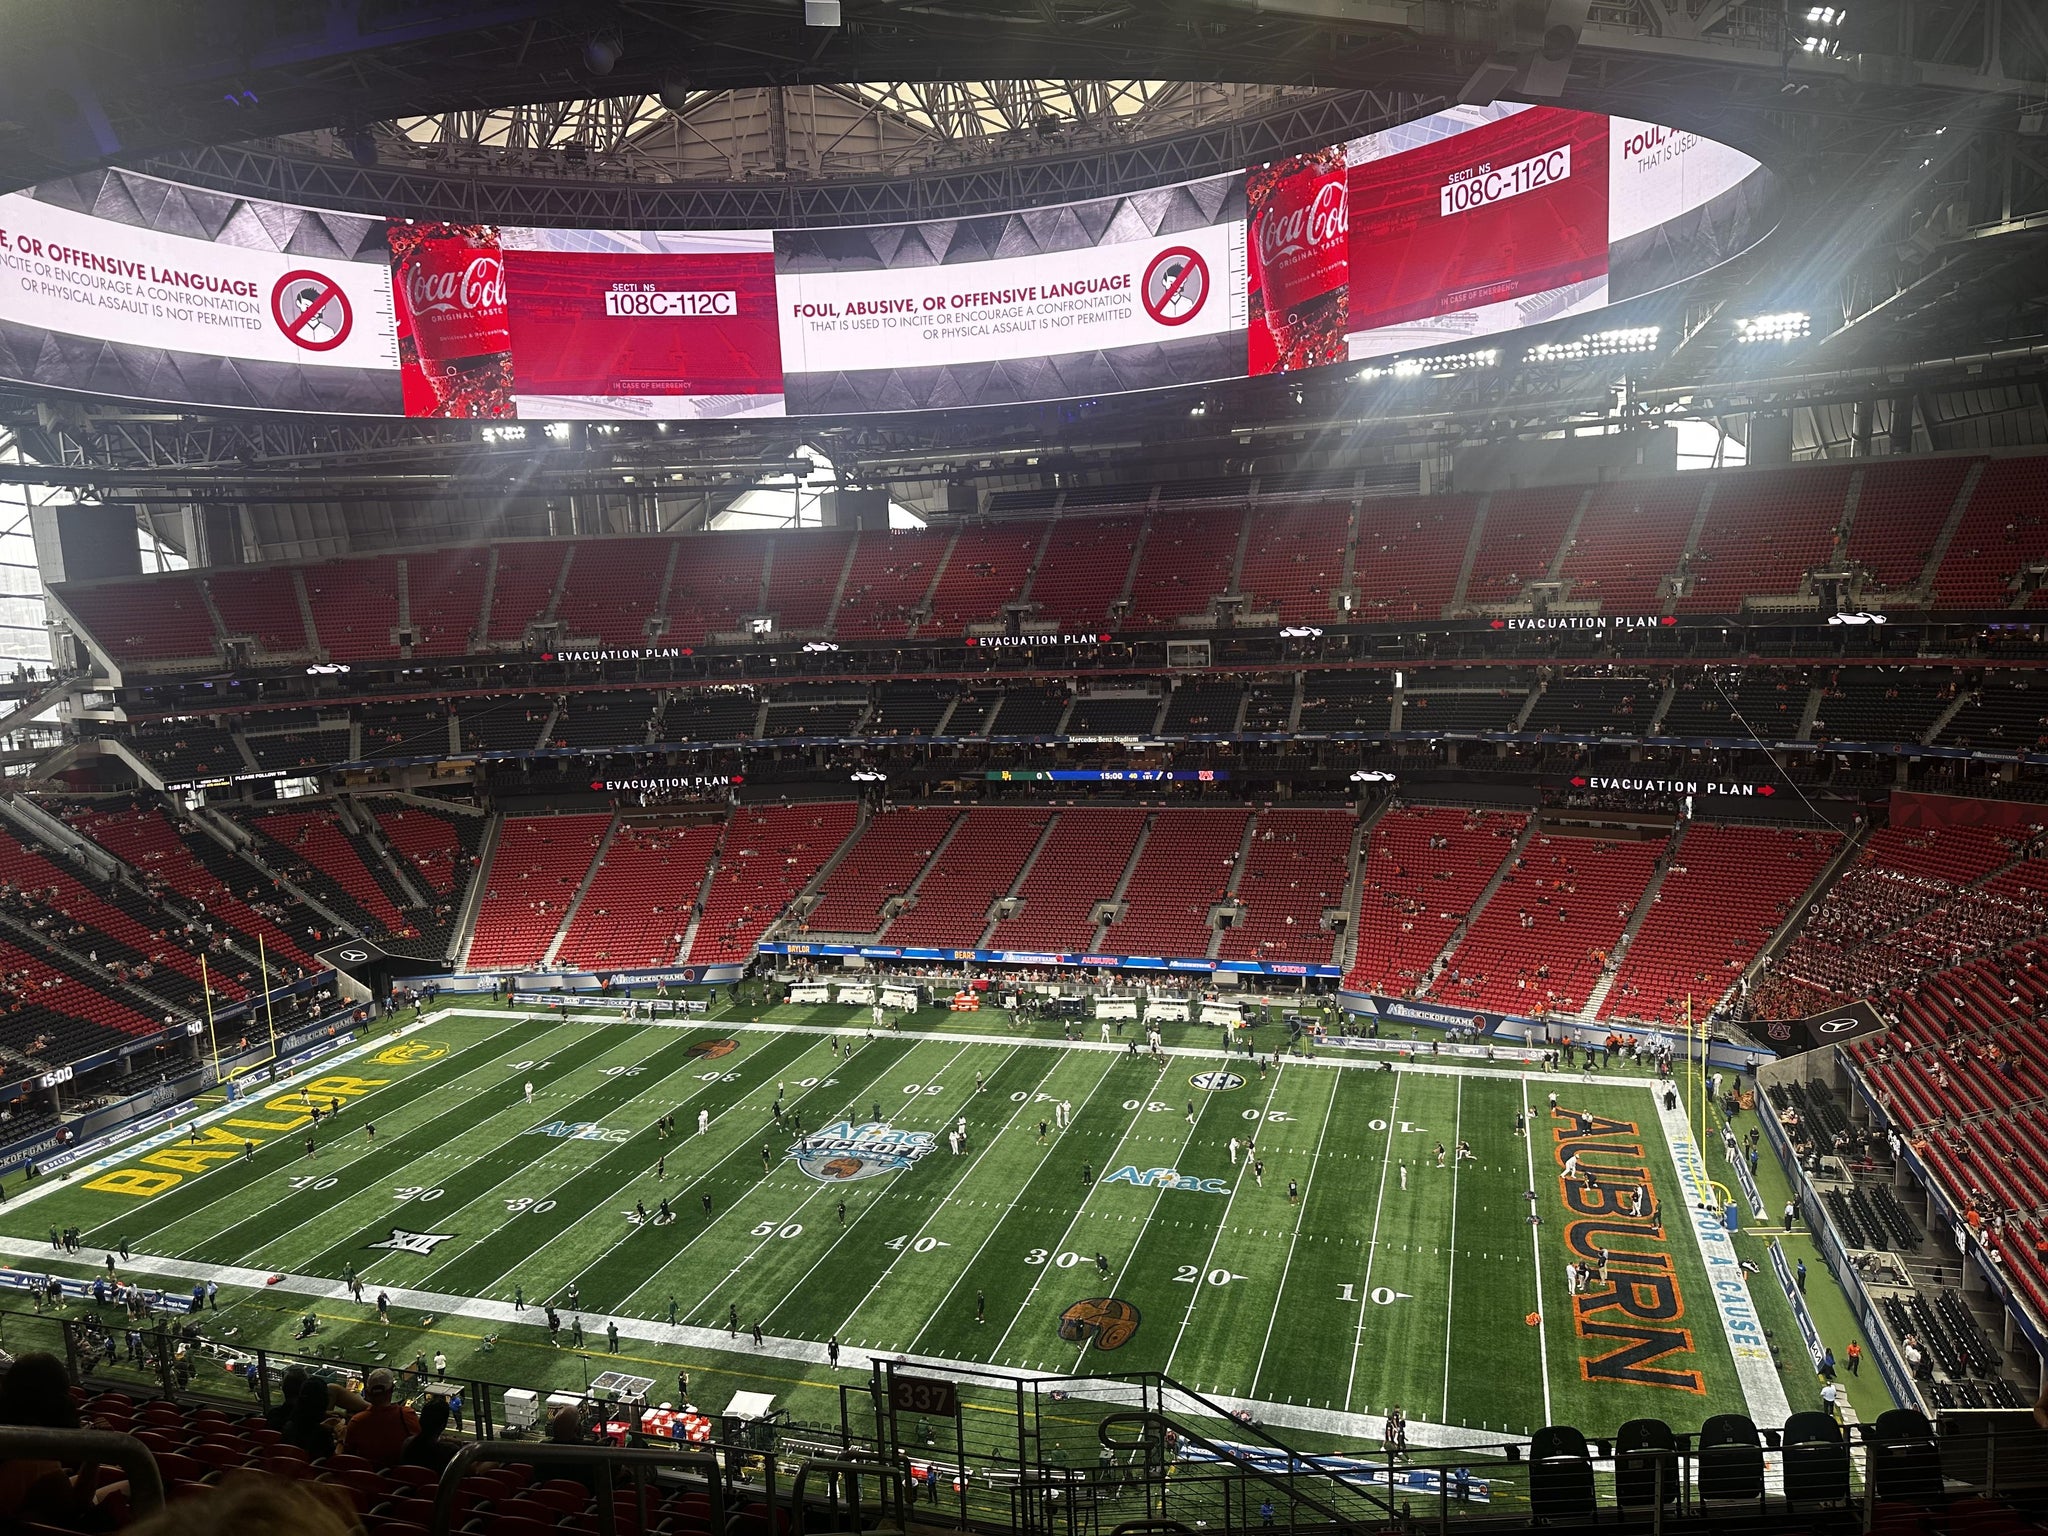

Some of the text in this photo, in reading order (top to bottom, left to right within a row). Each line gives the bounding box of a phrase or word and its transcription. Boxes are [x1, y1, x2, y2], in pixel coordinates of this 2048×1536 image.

[1624, 126, 1665, 160] FOUL,
[1638, 134, 1697, 173] THAT IS USED
[1445, 151, 1564, 212] 108C-112C
[1448, 163, 1491, 184] SECTINS
[1279, 236, 1345, 269] ORIGINAL TASTE
[17, 235, 258, 298] OR OFFENSIVE LANGUAGE
[34, 262, 52, 278] OR
[54, 267, 133, 295] ENCOURAGE
[136, 285, 145, 298] A
[148, 287, 261, 314] CONFRONTATION
[612, 283, 656, 292] SECTINS
[793, 273, 1131, 319] FOUL, ABUSIVE, OR OFFENSIVE LANGUAGE
[1450, 293, 1467, 304] CASE
[1478, 281, 1519, 298] EMERGENCY
[21, 277, 262, 331] OR PHYSICAL ASSAULT IS NOT PERMITTED
[609, 292, 731, 315] 108C-112C
[810, 292, 1132, 332] THAT IS USED TO INCITE OR ENCOURAGE A CONFRONTATION
[431, 307, 503, 323] ORIGINAL TASTE
[922, 307, 1132, 340] OR PHYSICAL ASSAULT IS NOT PERMITTED
[1508, 616, 1658, 630] EVACUATION PLAN
[980, 633, 1097, 647] EVACUATION PLAN
[557, 648, 679, 662] EVACUATION PLAN
[1069, 735, 1139, 743] Mercedes-Benz Stadium
[606, 775, 729, 790] EVACUATION PLAN
[1036, 772, 1043, 780] 0
[1100, 772, 1123, 780] 15:00
[1128, 772, 1138, 780] 40
[1166, 772, 1173, 780] 0
[1590, 777, 1753, 796] EVACUATION PLAN
[787, 944, 810, 953] BAYLOR
[954, 950, 976, 960] BEARS
[1081, 956, 1118, 965] AUBURN
[1271, 964, 1307, 974] TIGERS
[1416, 1010, 1450, 1023] KICKOFF
[307, 1024, 336, 1042] KICKO
[518, 1059, 555, 1072] 10
[605, 1065, 648, 1078] 20
[42, 1066, 73, 1089] 15:00
[702, 1070, 742, 1083] 30
[799, 1076, 840, 1089] 40
[1190, 1071, 1243, 1090] SEC
[902, 1082, 944, 1097] 50
[1010, 1090, 1056, 1103] 40
[1122, 1099, 1168, 1113] 30
[1241, 1108, 1288, 1122] 20
[1368, 1119, 1415, 1133] 10
[81, 1076, 391, 1197] BAYLOR
[109, 1129, 133, 1142] HONDA
[29, 1139, 58, 1156] GAME
[803, 1137, 938, 1161] KICKOFF
[48, 1155, 71, 1168] DELTA
[291, 1174, 339, 1191] 10
[398, 1186, 445, 1204] 20
[506, 1196, 557, 1214] 30
[751, 1221, 803, 1240] 50
[1693, 1210, 1725, 1243] FOR
[883, 1234, 938, 1253] 40
[1552, 1106, 1707, 1395] AUBURN
[1023, 1248, 1079, 1269] 30
[1708, 1255, 1734, 1266] A
[1172, 1265, 1231, 1287] 20
[1335, 1283, 1396, 1306] 10
[1716, 1280, 1762, 1347] CAUSE
[898, 1382, 948, 1412] 337
[655, 1427, 664, 1436] G
